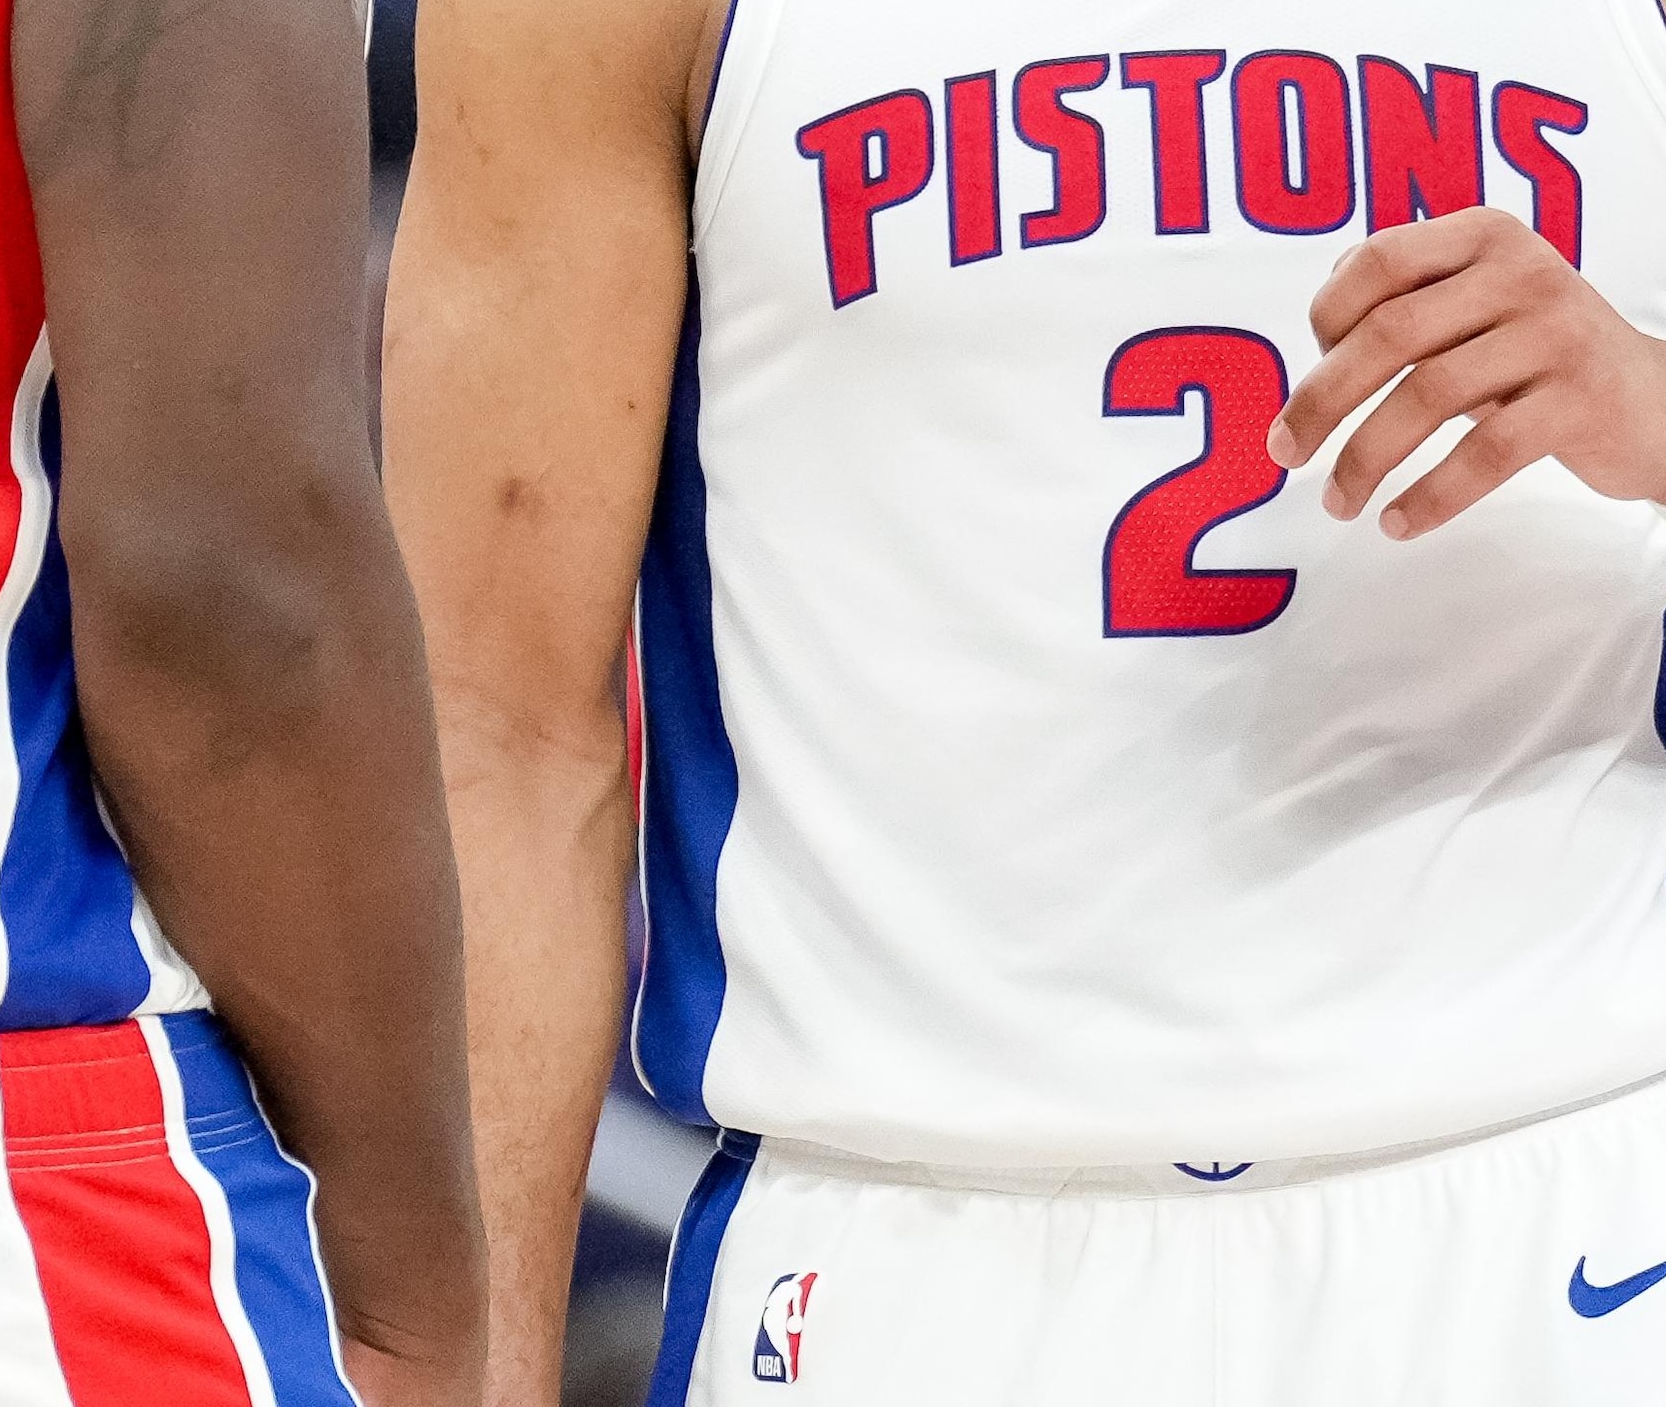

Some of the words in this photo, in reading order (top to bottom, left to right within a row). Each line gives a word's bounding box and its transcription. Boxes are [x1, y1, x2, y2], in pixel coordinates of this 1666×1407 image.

[796, 49, 1588, 310] PISTONS
[1102, 326, 1297, 638] 2
[756, 1355, 782, 1377] NBA
